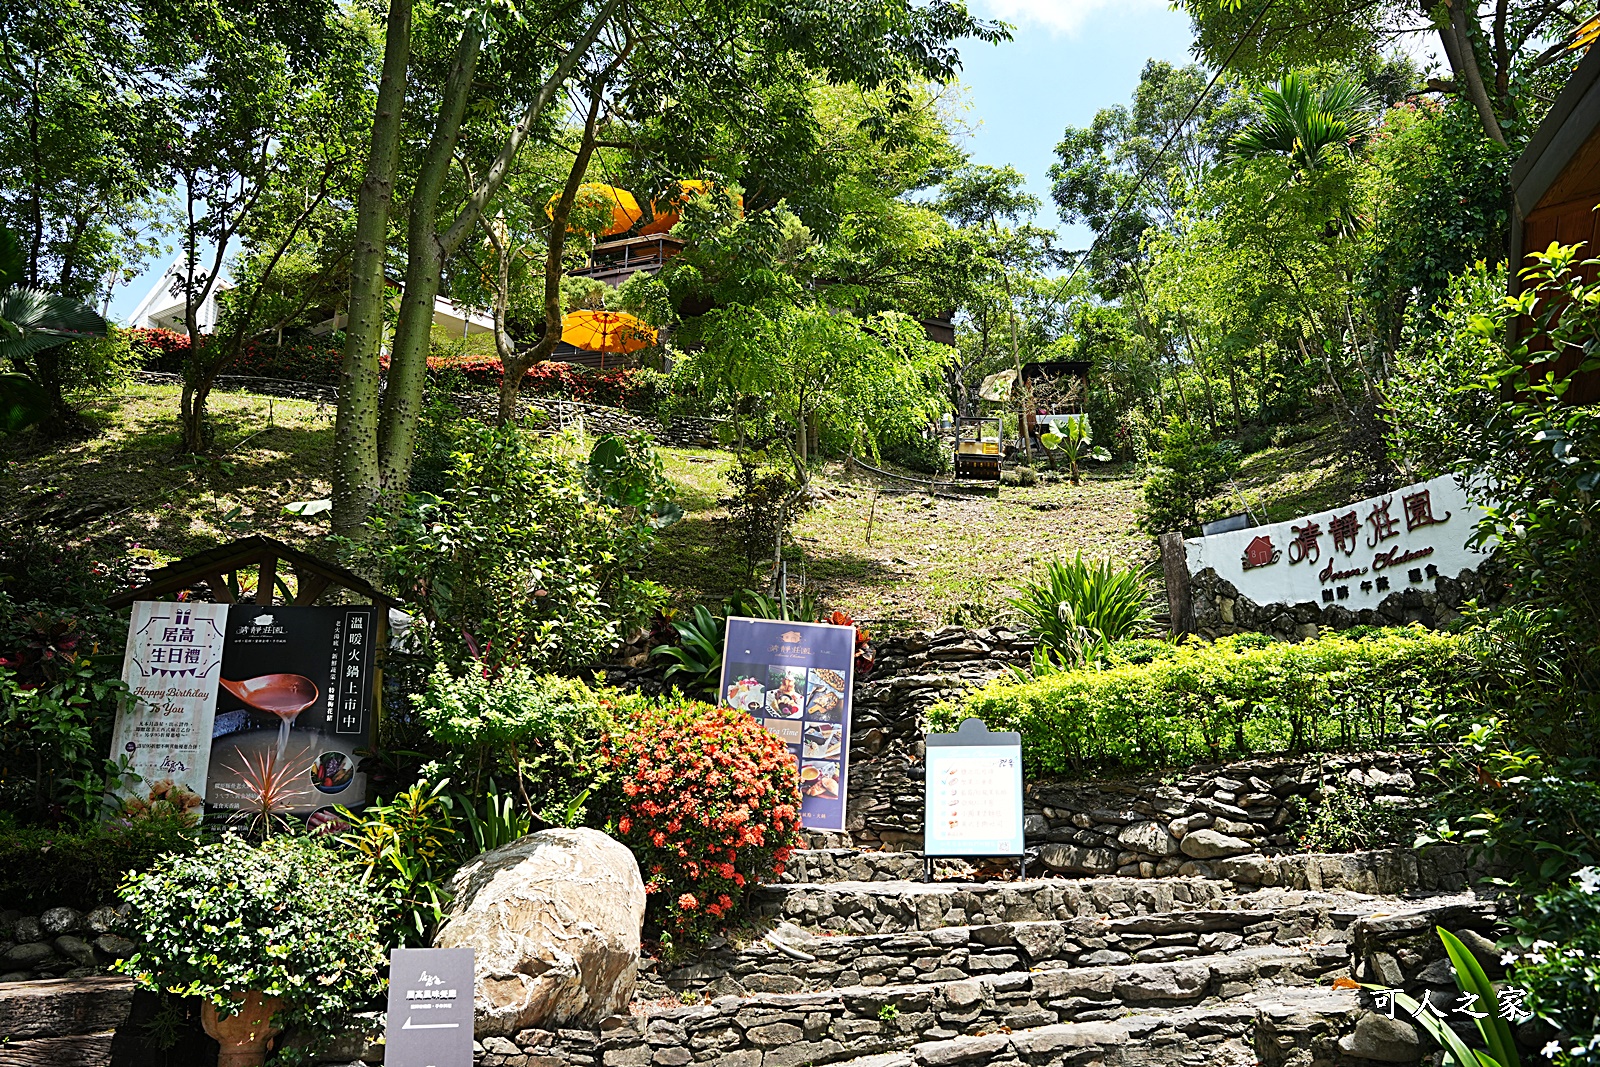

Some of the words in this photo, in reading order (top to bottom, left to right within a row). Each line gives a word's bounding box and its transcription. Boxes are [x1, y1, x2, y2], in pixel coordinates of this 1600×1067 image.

[1288, 489, 1451, 564] 清靜莊園
[1372, 545, 1435, 570] Chateau
[162, 627, 195, 642] 居高
[151, 648, 201, 664] 生日禮
[343, 616, 363, 728] 溫暖火鍋上市中
[133, 687, 166, 699] Happy
[166, 687, 209, 701] Birthday
[162, 703, 184, 716] You
